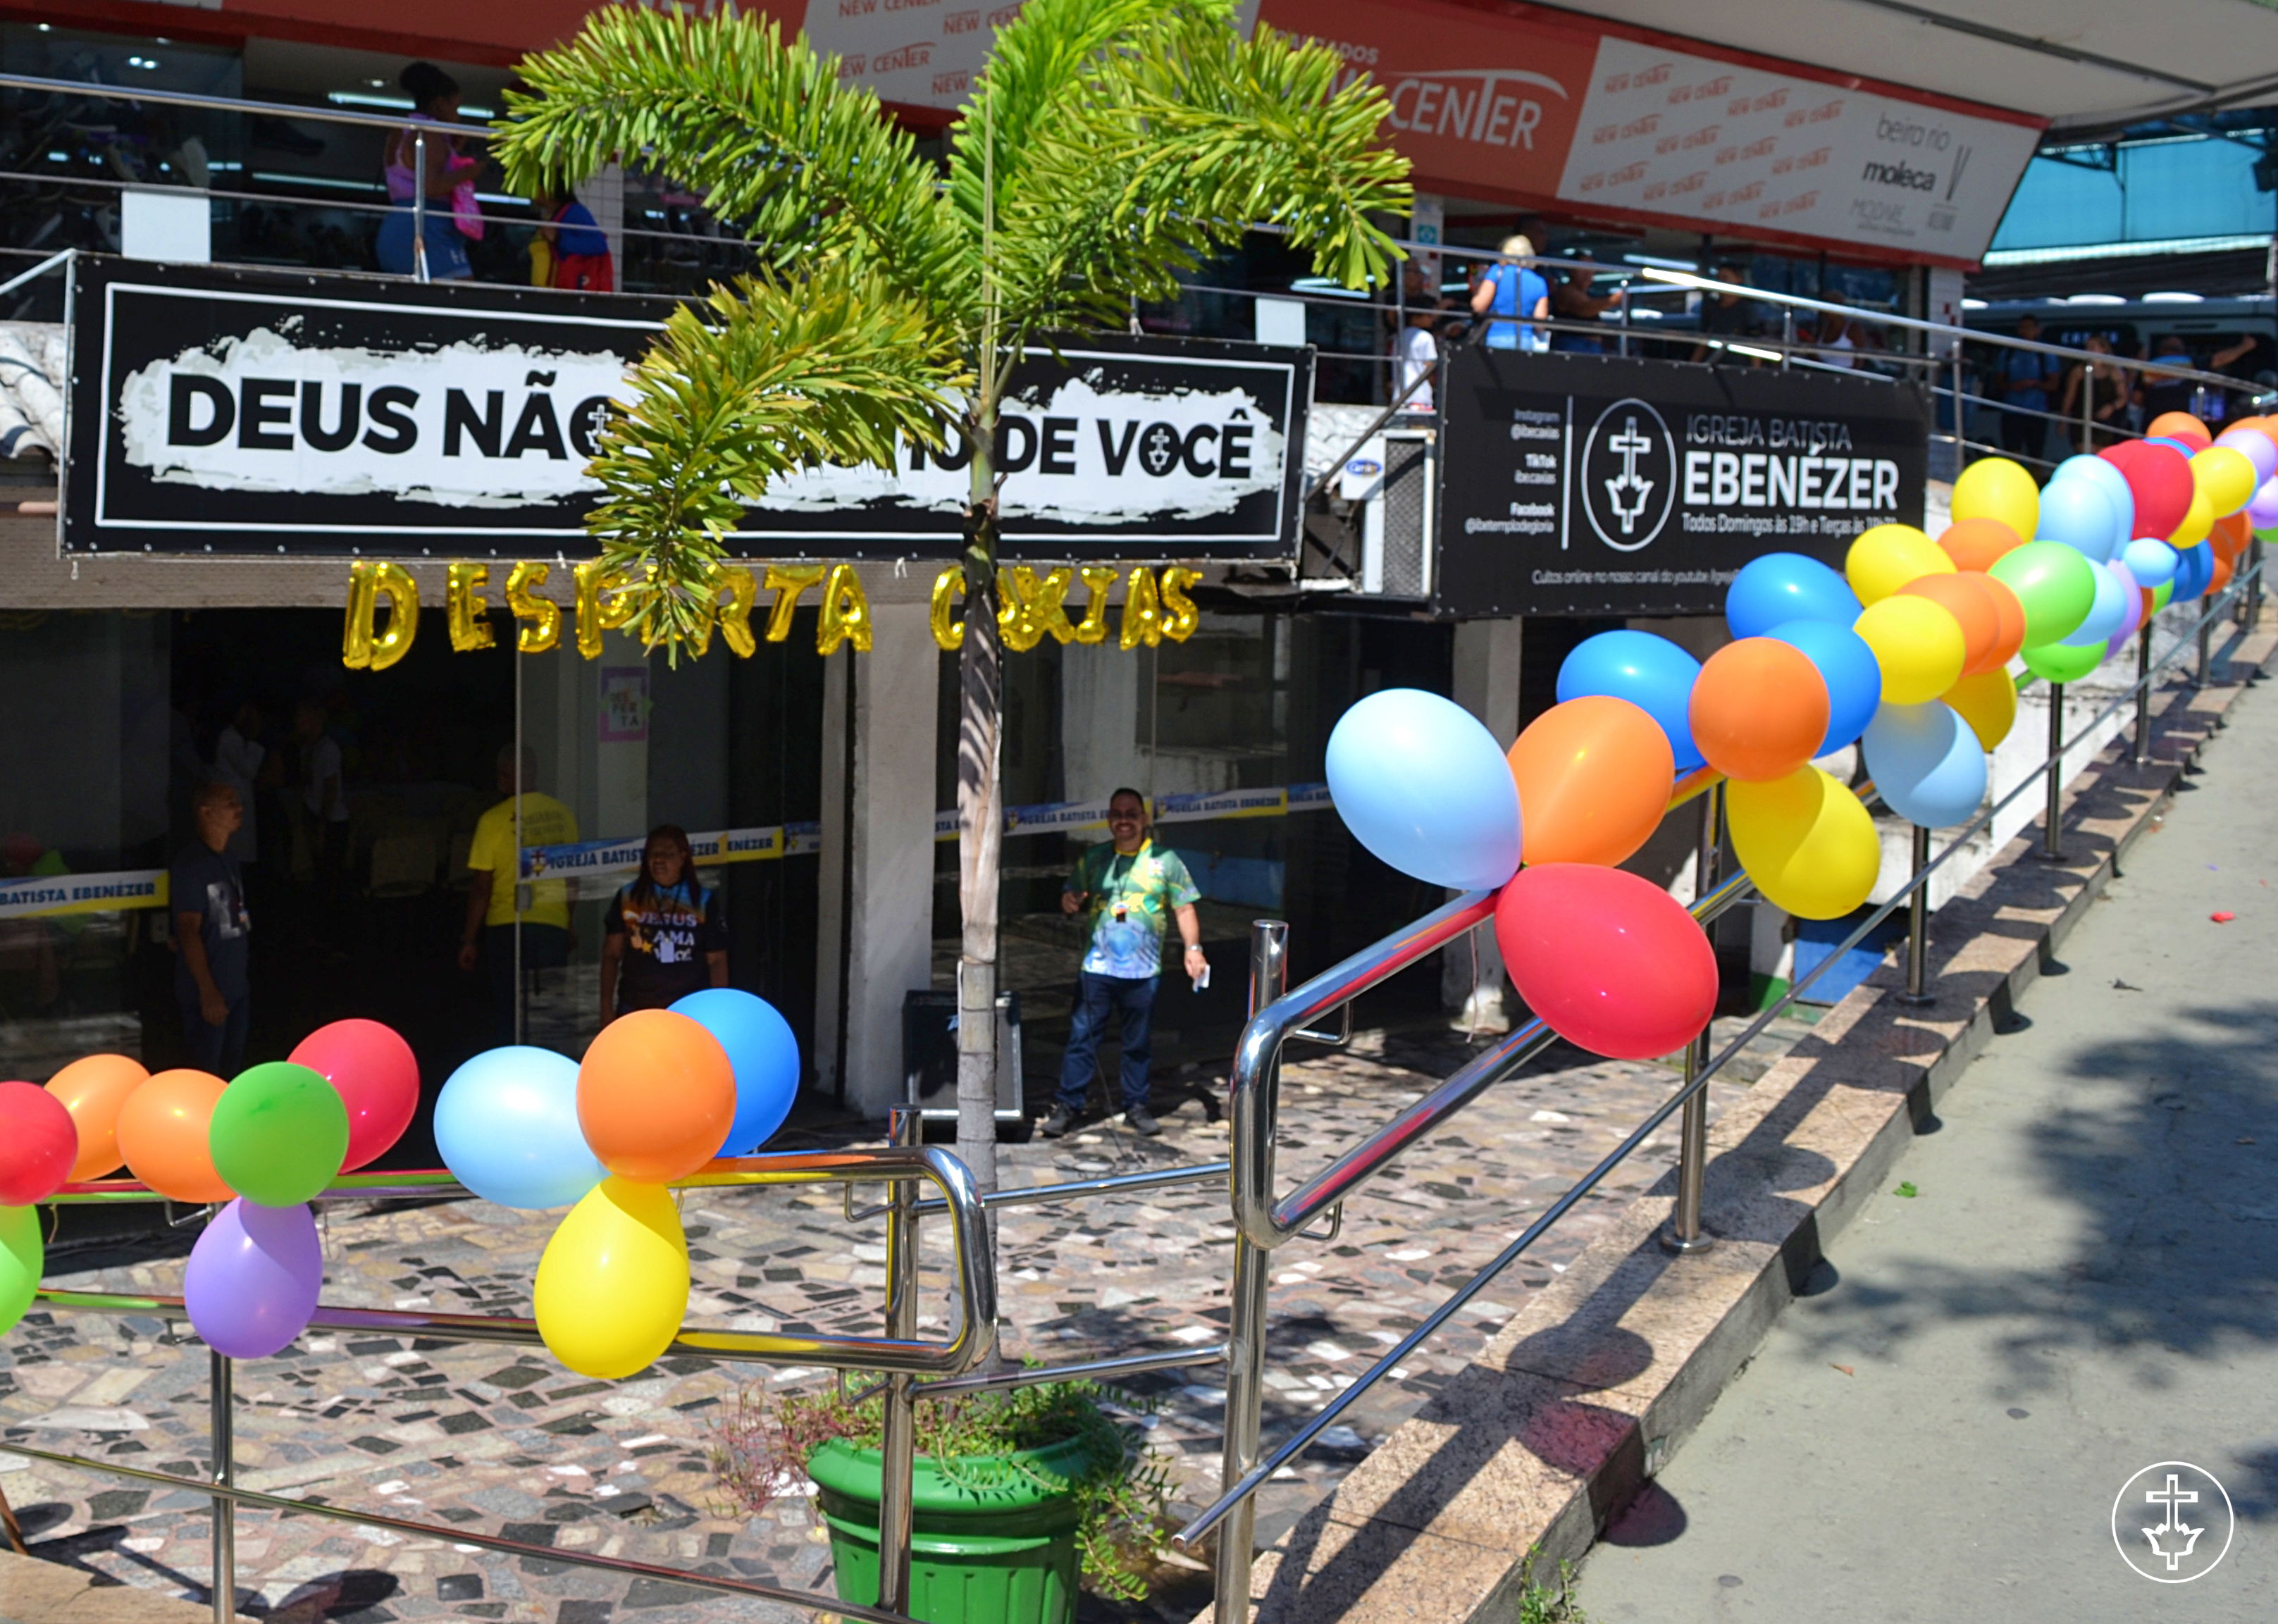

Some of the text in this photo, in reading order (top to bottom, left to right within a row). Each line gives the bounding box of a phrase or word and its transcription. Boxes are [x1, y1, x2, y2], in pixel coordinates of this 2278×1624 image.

[839, 1, 876, 17] NEW
[943, 14, 980, 34] NEW
[838, 42, 935, 79] EW CENTER
[931, 75, 968, 94] NEW
[1387, 69, 1568, 150] CENTER
[1862, 159, 1936, 191] moleca
[167, 370, 629, 460] DEUS NÃO
[994, 407, 1256, 479] DE VOCÊ
[1686, 414, 1852, 451] IGREJA BATISTA
[1684, 443, 1899, 510] EBENÉZER
[1681, 512, 1716, 532] Todos
[1717, 513, 1774, 537] Domingos
[727, 836, 773, 851] ENÉZER
[550, 853, 597, 869] IGREJA
[602, 848, 643, 865] BATIST
[0, 880, 155, 905] BATISTA EBENÉZER
